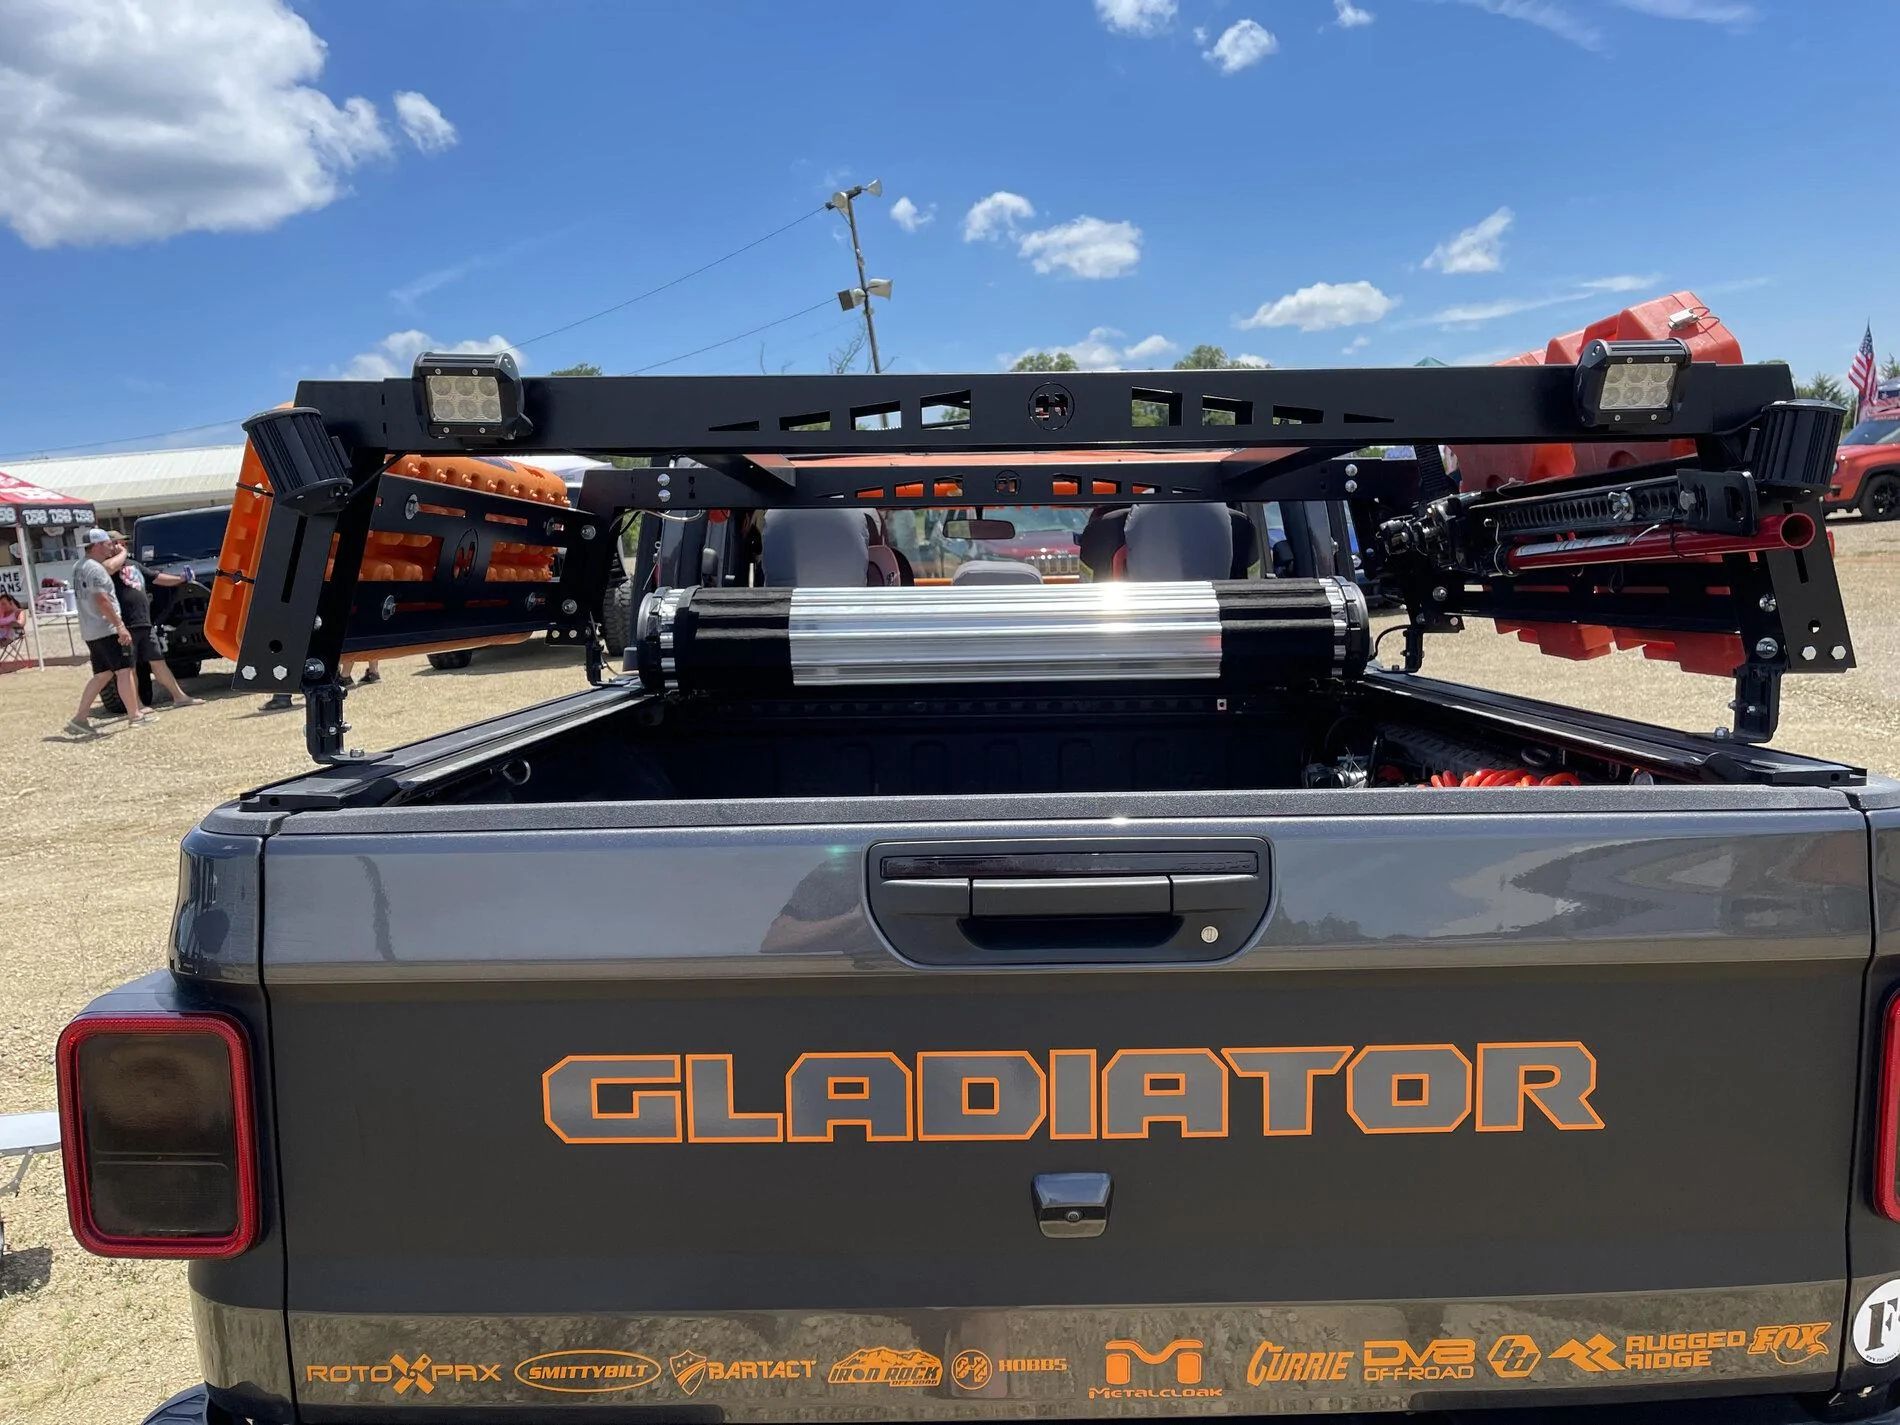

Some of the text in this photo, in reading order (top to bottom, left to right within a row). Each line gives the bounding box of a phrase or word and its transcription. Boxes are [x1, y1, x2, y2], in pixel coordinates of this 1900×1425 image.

[541, 1040, 1606, 1145] GLADIATOR
[1626, 1330, 1747, 1353] RUGGED
[1747, 1322, 1832, 1359] FOX
[1246, 1339, 1356, 1387] CURRIE
[1363, 1338, 1476, 1367] DV8
[1625, 1350, 1713, 1370] RIDGE
[528, 1364, 648, 1380] SMITTYBILT
[708, 1359, 818, 1380] BARTACT
[830, 1365, 940, 1382] IRON ROCK
[998, 1357, 1068, 1373] HOBBS
